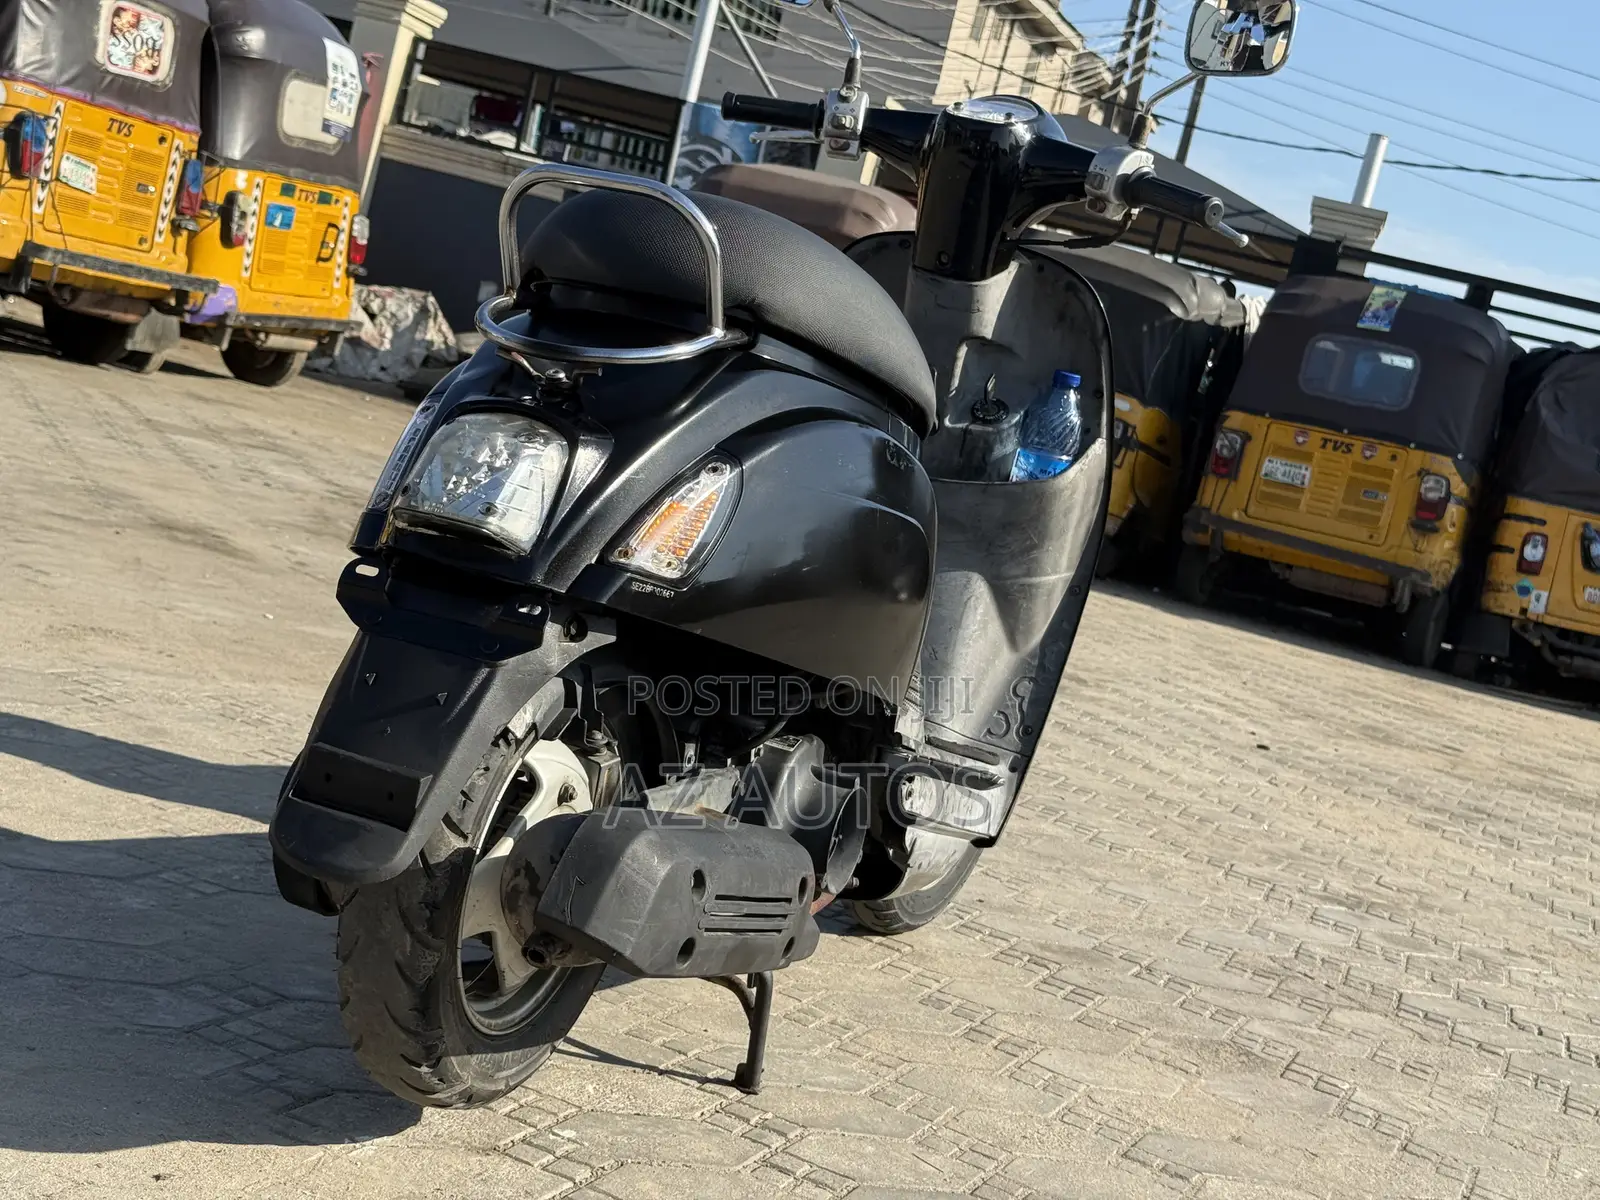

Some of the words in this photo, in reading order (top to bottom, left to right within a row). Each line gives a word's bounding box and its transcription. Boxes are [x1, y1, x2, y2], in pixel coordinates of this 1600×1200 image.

[106, 117, 135, 138] TVS
[297, 188, 317, 204] TVS
[1319, 436, 1354, 454] TVS
